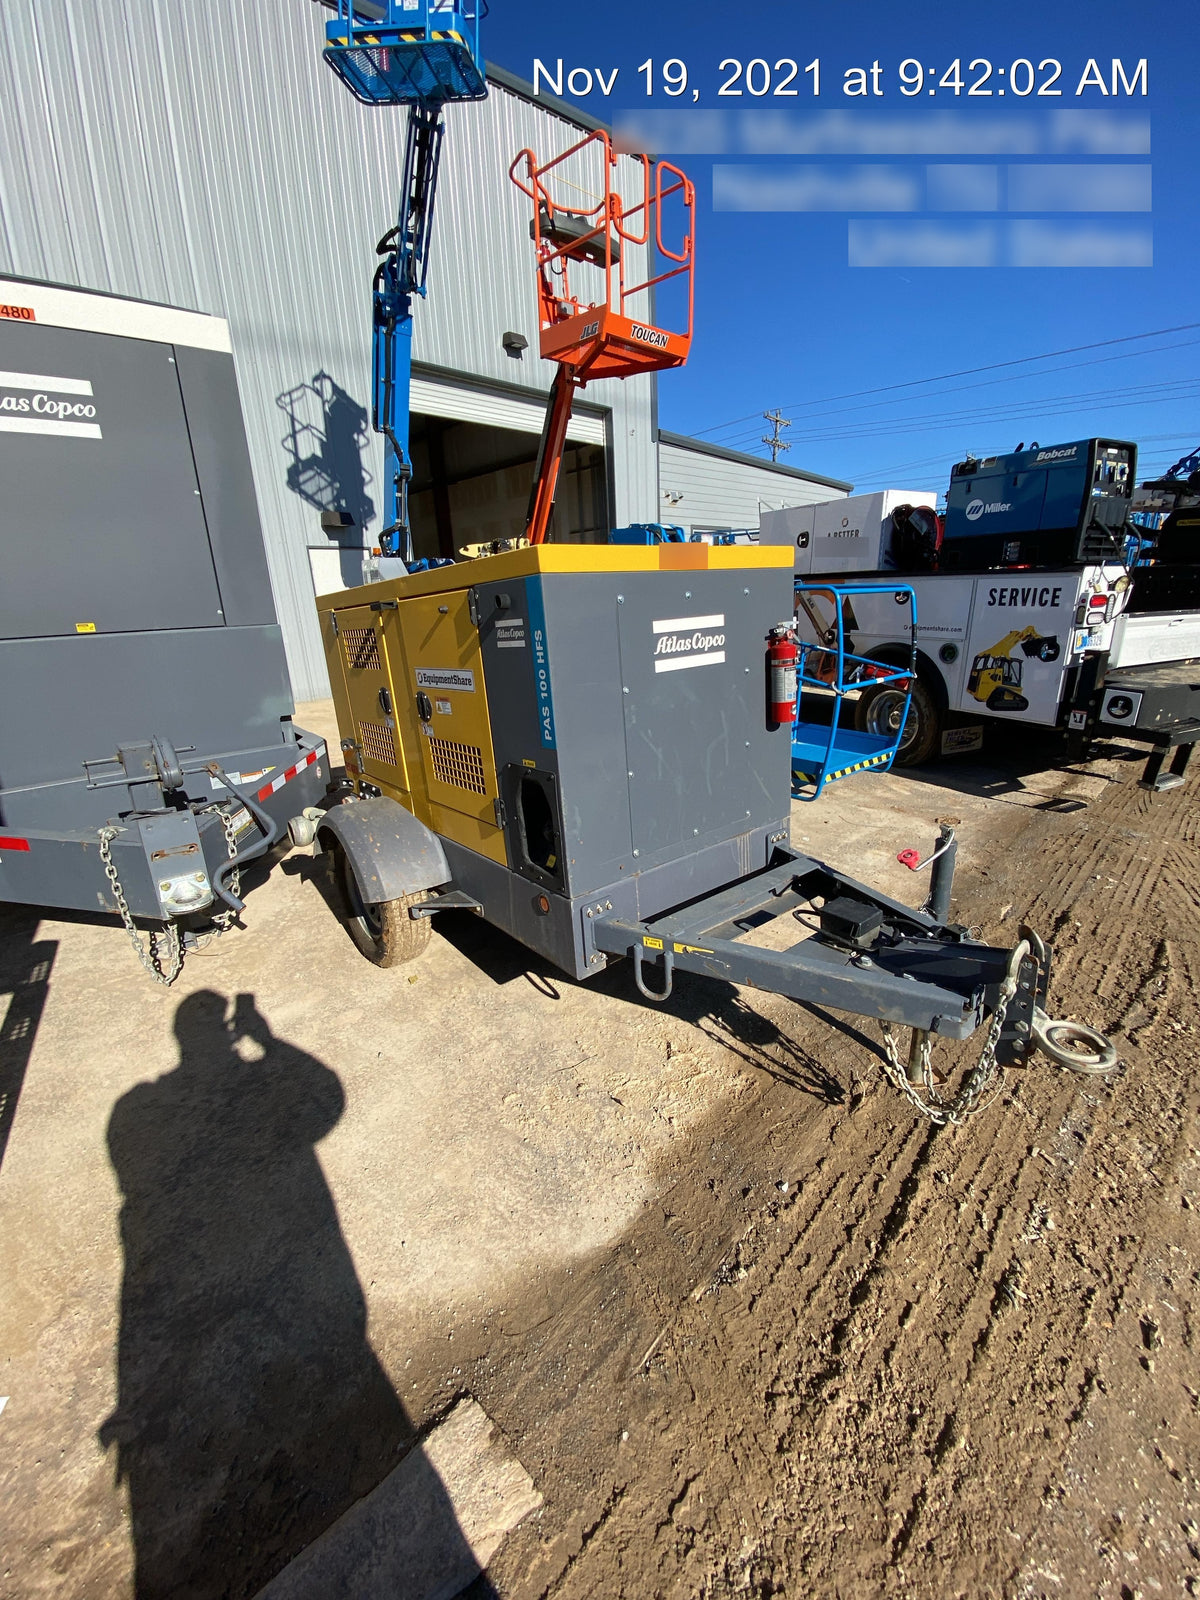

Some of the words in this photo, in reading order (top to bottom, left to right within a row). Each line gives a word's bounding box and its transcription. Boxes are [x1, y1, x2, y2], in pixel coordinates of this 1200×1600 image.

[580, 321, 600, 340] JLG
[631, 324, 668, 348] TOUCAN
[32, 393, 97, 419] Copco
[1036, 446, 1078, 461] Bobcat
[984, 502, 1011, 514] Miller
[987, 587, 1063, 607] SERVICE
[534, 629, 545, 664] HFS
[653, 635, 692, 655] Atlas
[692, 632, 726, 652] Copco
[423, 672, 473, 687] EquipmentShare
[538, 669, 548, 699] 100
[542, 705, 553, 741] PAS
